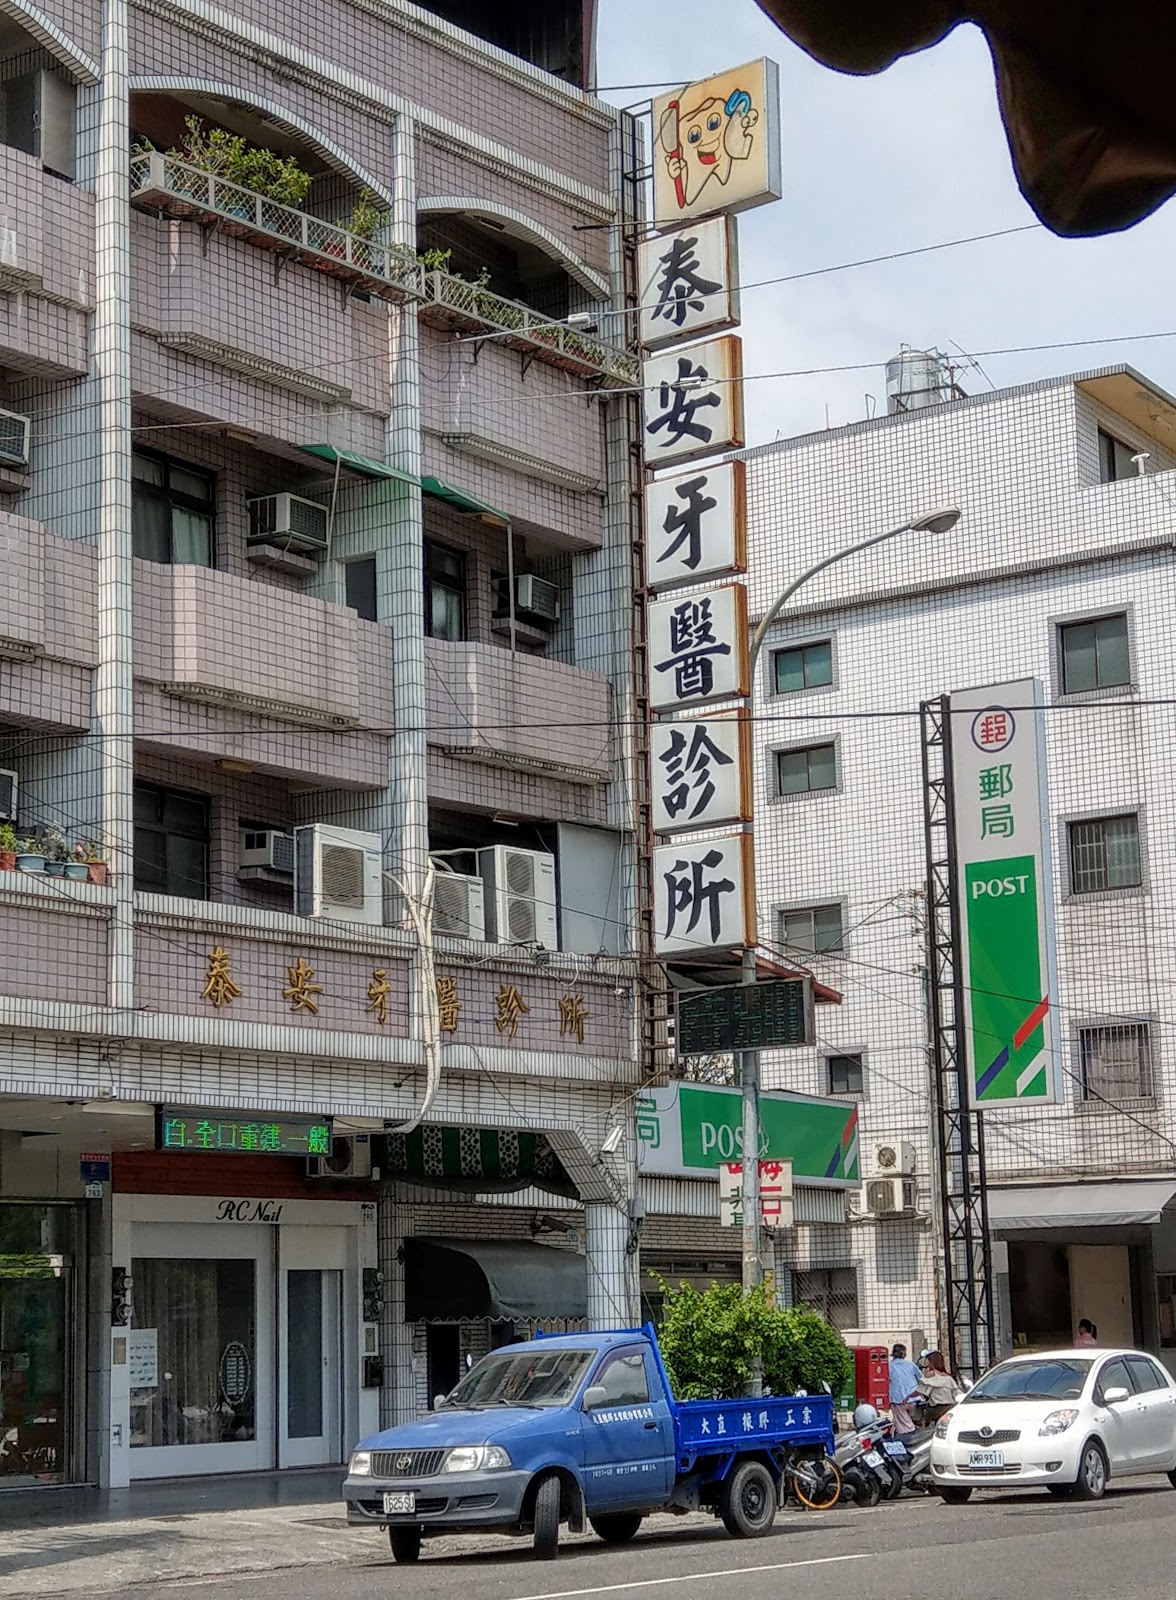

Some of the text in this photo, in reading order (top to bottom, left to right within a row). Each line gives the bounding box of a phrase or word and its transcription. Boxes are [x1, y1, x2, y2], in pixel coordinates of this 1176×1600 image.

[646, 237, 735, 943] 泰安牙醫診所
[980, 713, 1007, 745] 郵
[979, 763, 1014, 840] 郵局
[972, 875, 1029, 900] POST
[202, 945, 589, 1044] 泰安牙醫診所
[701, 1121, 744, 1159] POS
[216, 1200, 283, 1222] RC Nail
